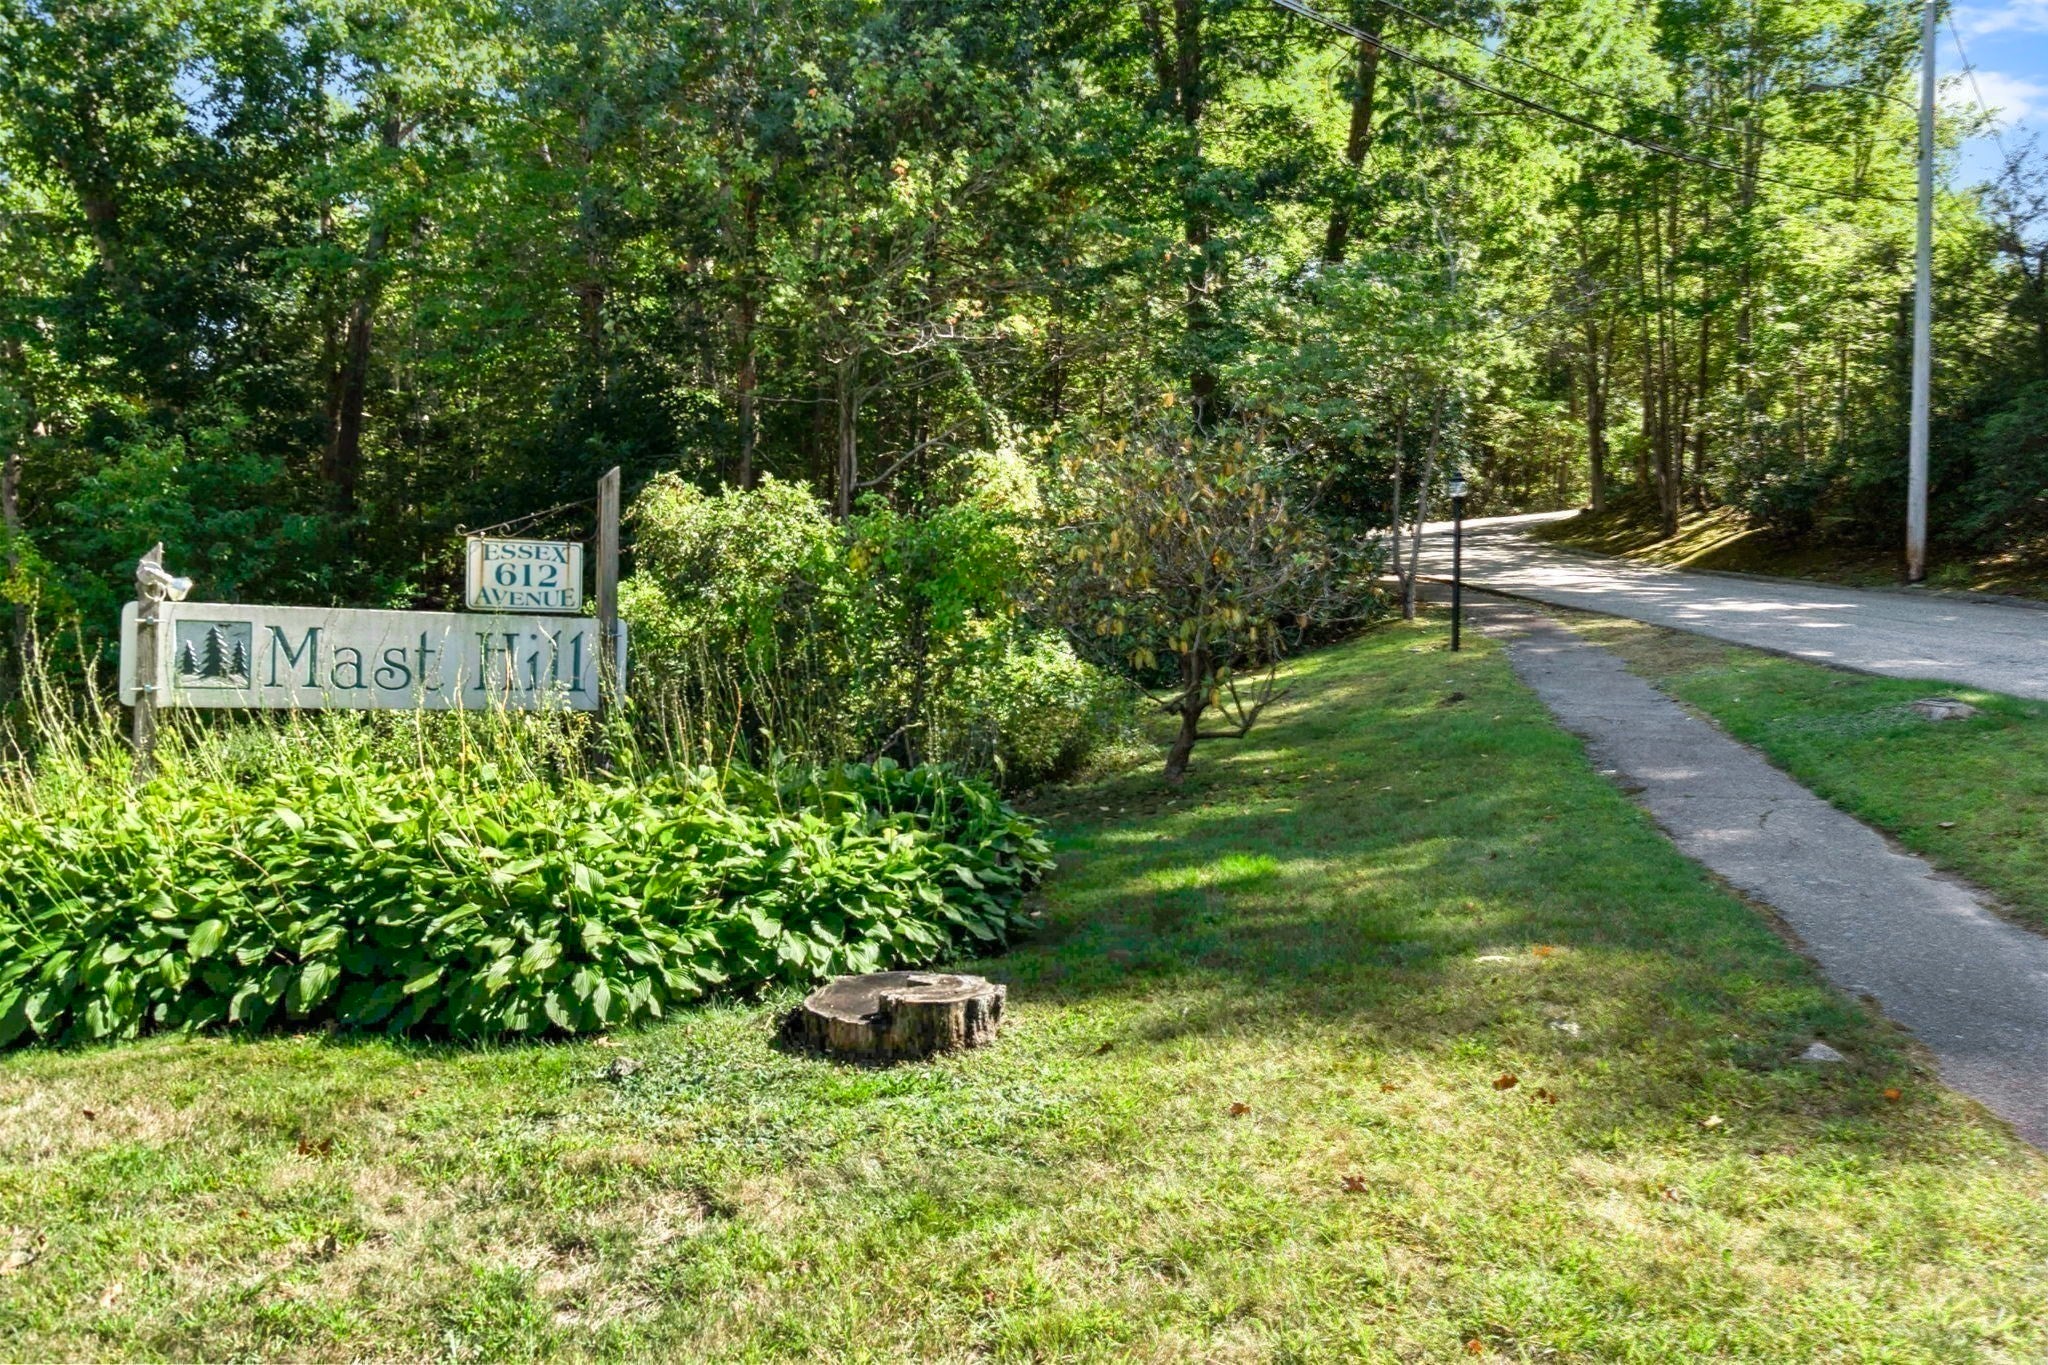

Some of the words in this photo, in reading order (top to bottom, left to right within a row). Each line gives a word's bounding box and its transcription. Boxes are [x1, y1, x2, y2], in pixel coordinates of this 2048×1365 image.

[484, 543, 569, 564] ESSEX
[495, 563, 558, 587] 612
[475, 586, 576, 607] AVENUE
[264, 625, 445, 691] Mast
[473, 630, 586, 692] Hill
